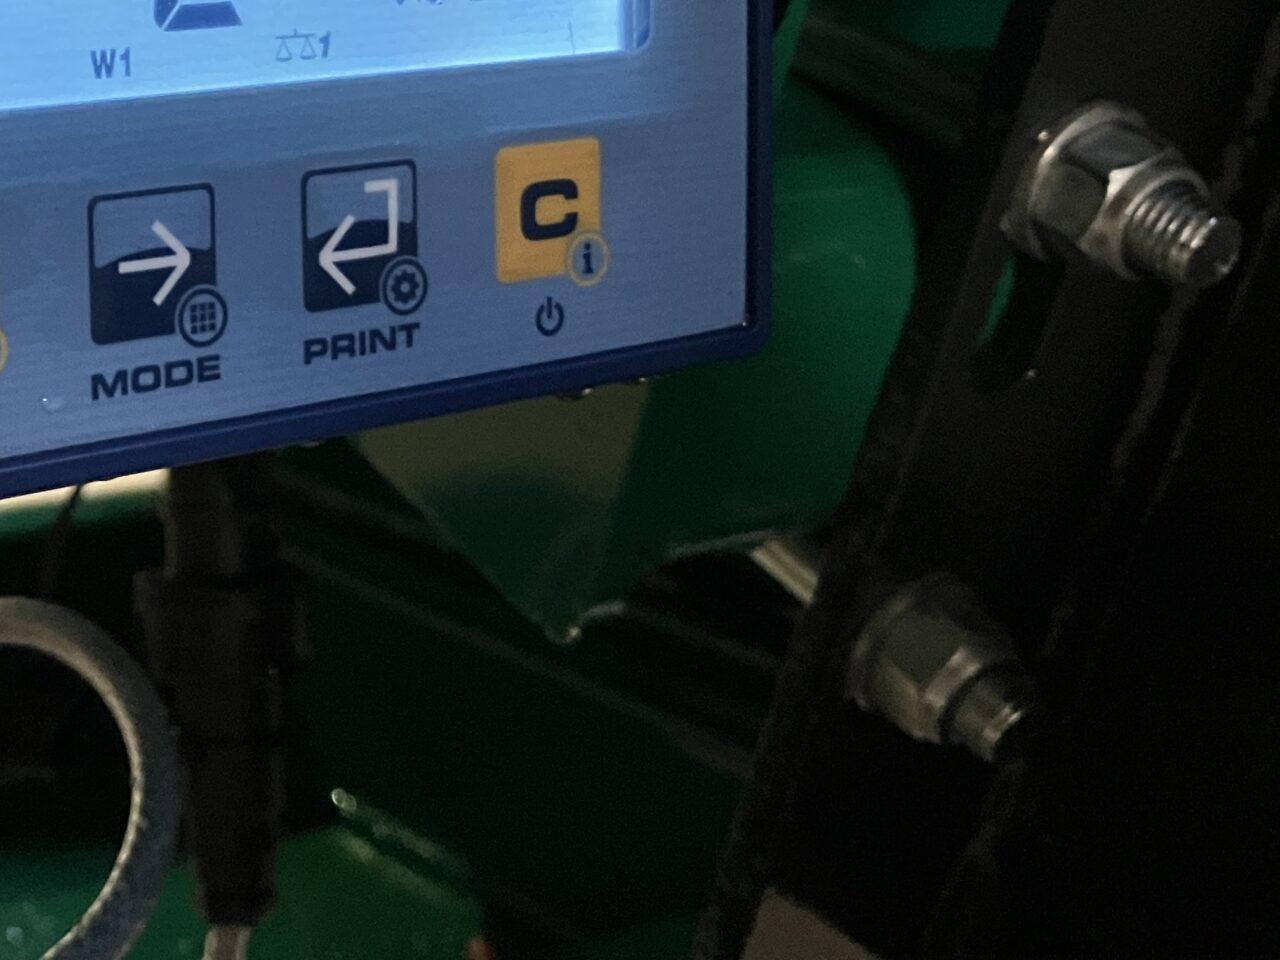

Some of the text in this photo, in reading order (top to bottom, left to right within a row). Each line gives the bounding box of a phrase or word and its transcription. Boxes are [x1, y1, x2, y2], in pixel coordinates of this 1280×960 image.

[90, 47, 132, 79] W1
[519, 178, 579, 241] C
[303, 322, 421, 365] PRINT
[90, 353, 222, 401] MODE
